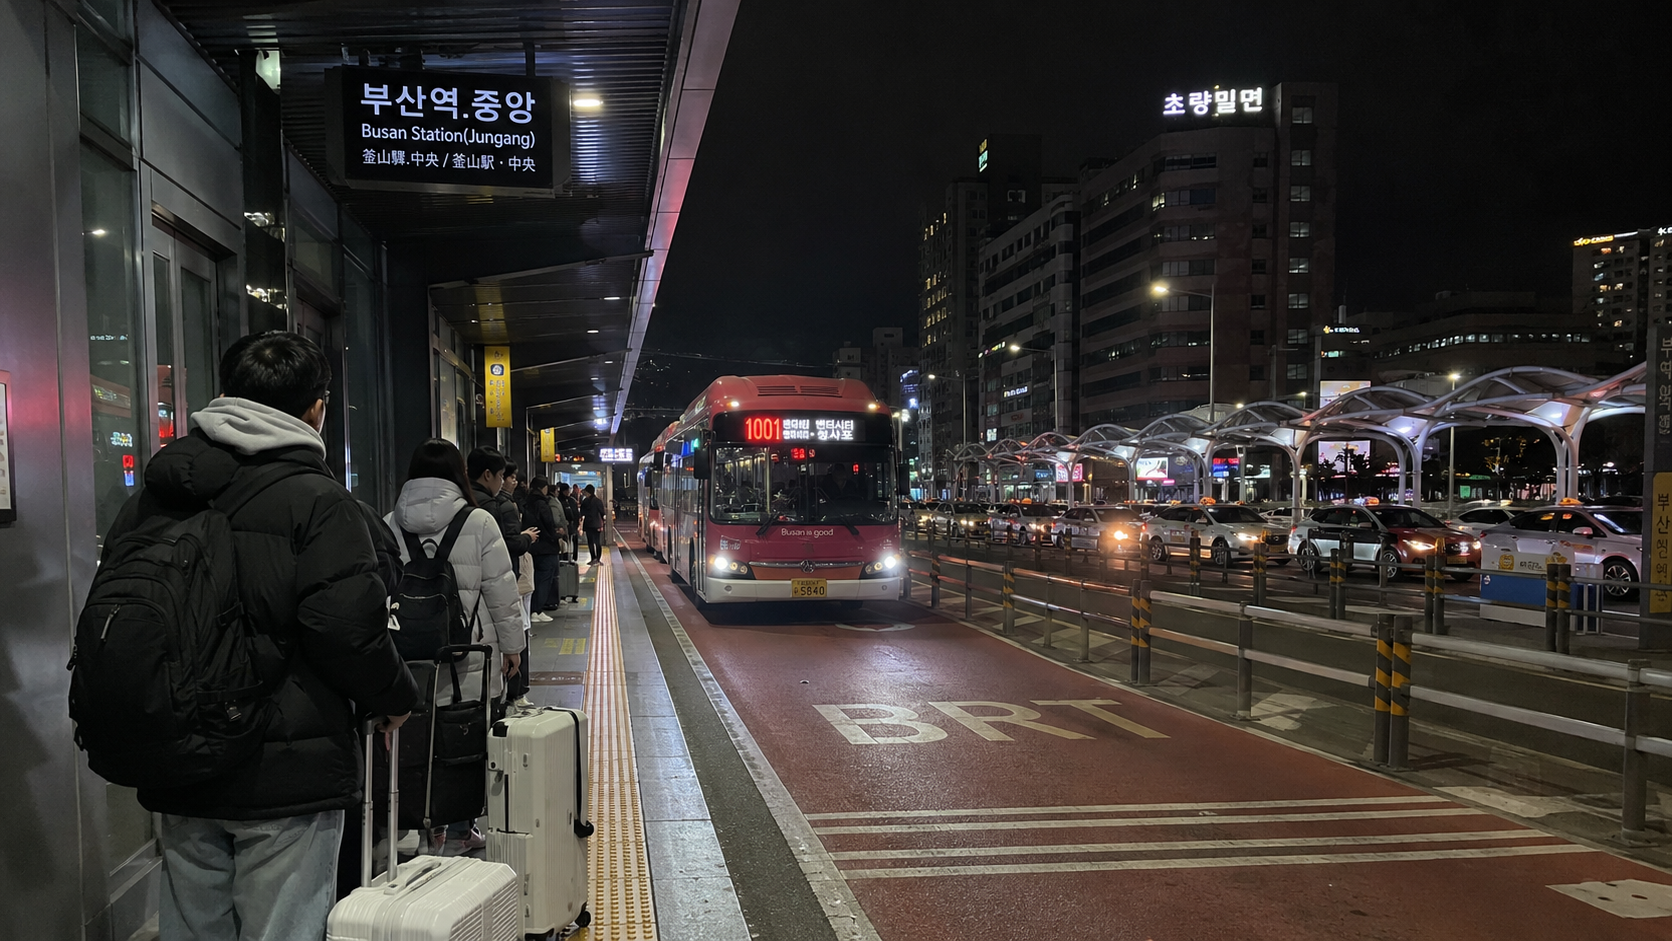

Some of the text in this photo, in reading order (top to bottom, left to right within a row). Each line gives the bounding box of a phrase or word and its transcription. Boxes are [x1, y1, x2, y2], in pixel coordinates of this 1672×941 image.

[361, 83, 536, 124] 부산역.중앙
[1163, 87, 1263, 115] 초량밀면
[362, 123, 536, 149] Busan Station(Jungang)
[745, 418, 780, 440] 1001
[781, 528, 805, 536] Busan
[813, 528, 834, 539] good
[800, 586, 825, 596] 5840
[812, 697, 1171, 745] BRT
